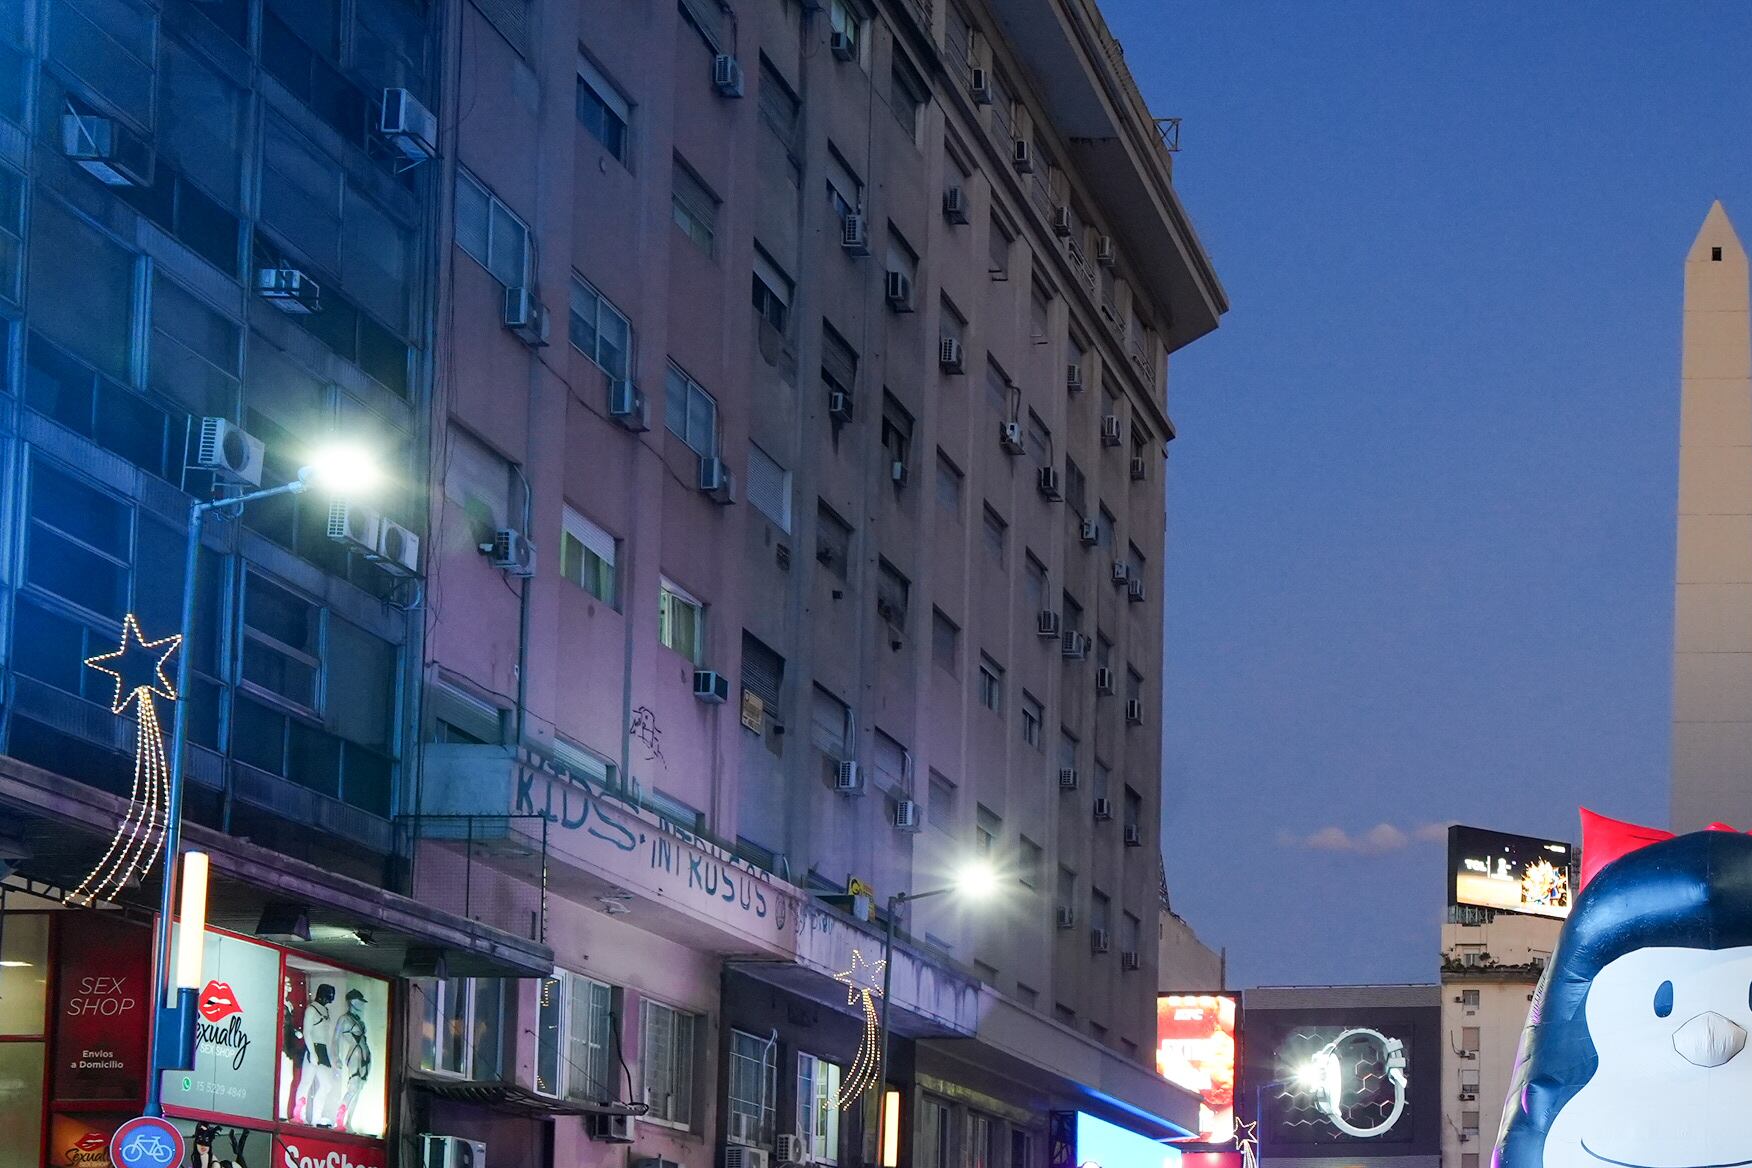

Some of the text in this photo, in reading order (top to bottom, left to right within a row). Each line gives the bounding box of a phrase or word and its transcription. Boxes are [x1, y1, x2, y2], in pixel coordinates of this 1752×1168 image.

[78, 976, 127, 995] SEX
[67, 998, 135, 1016] SHOP
[196, 1013, 251, 1070] exually
[79, 1060, 124, 1069] Domicilio
